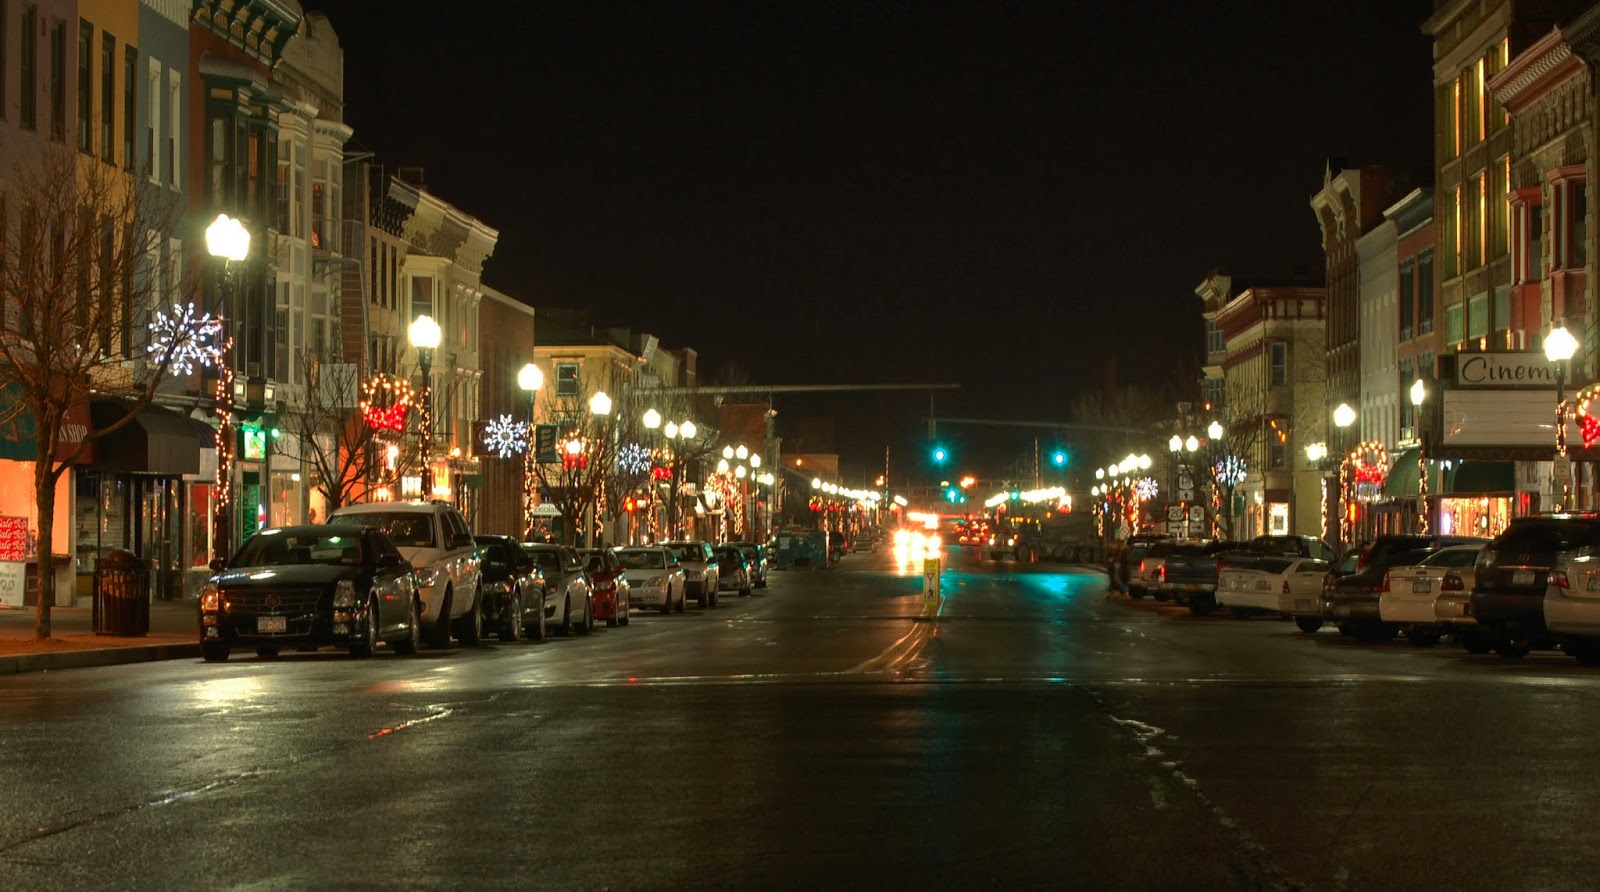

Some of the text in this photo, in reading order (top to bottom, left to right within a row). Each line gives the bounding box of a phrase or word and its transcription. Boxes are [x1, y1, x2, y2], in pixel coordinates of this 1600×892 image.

[67, 423, 88, 444] SHOP
[1171, 508, 1183, 518] 20
[1194, 508, 1200, 518] 5
[0, 539, 12, 549] ale
[0, 550, 11, 560] ale
